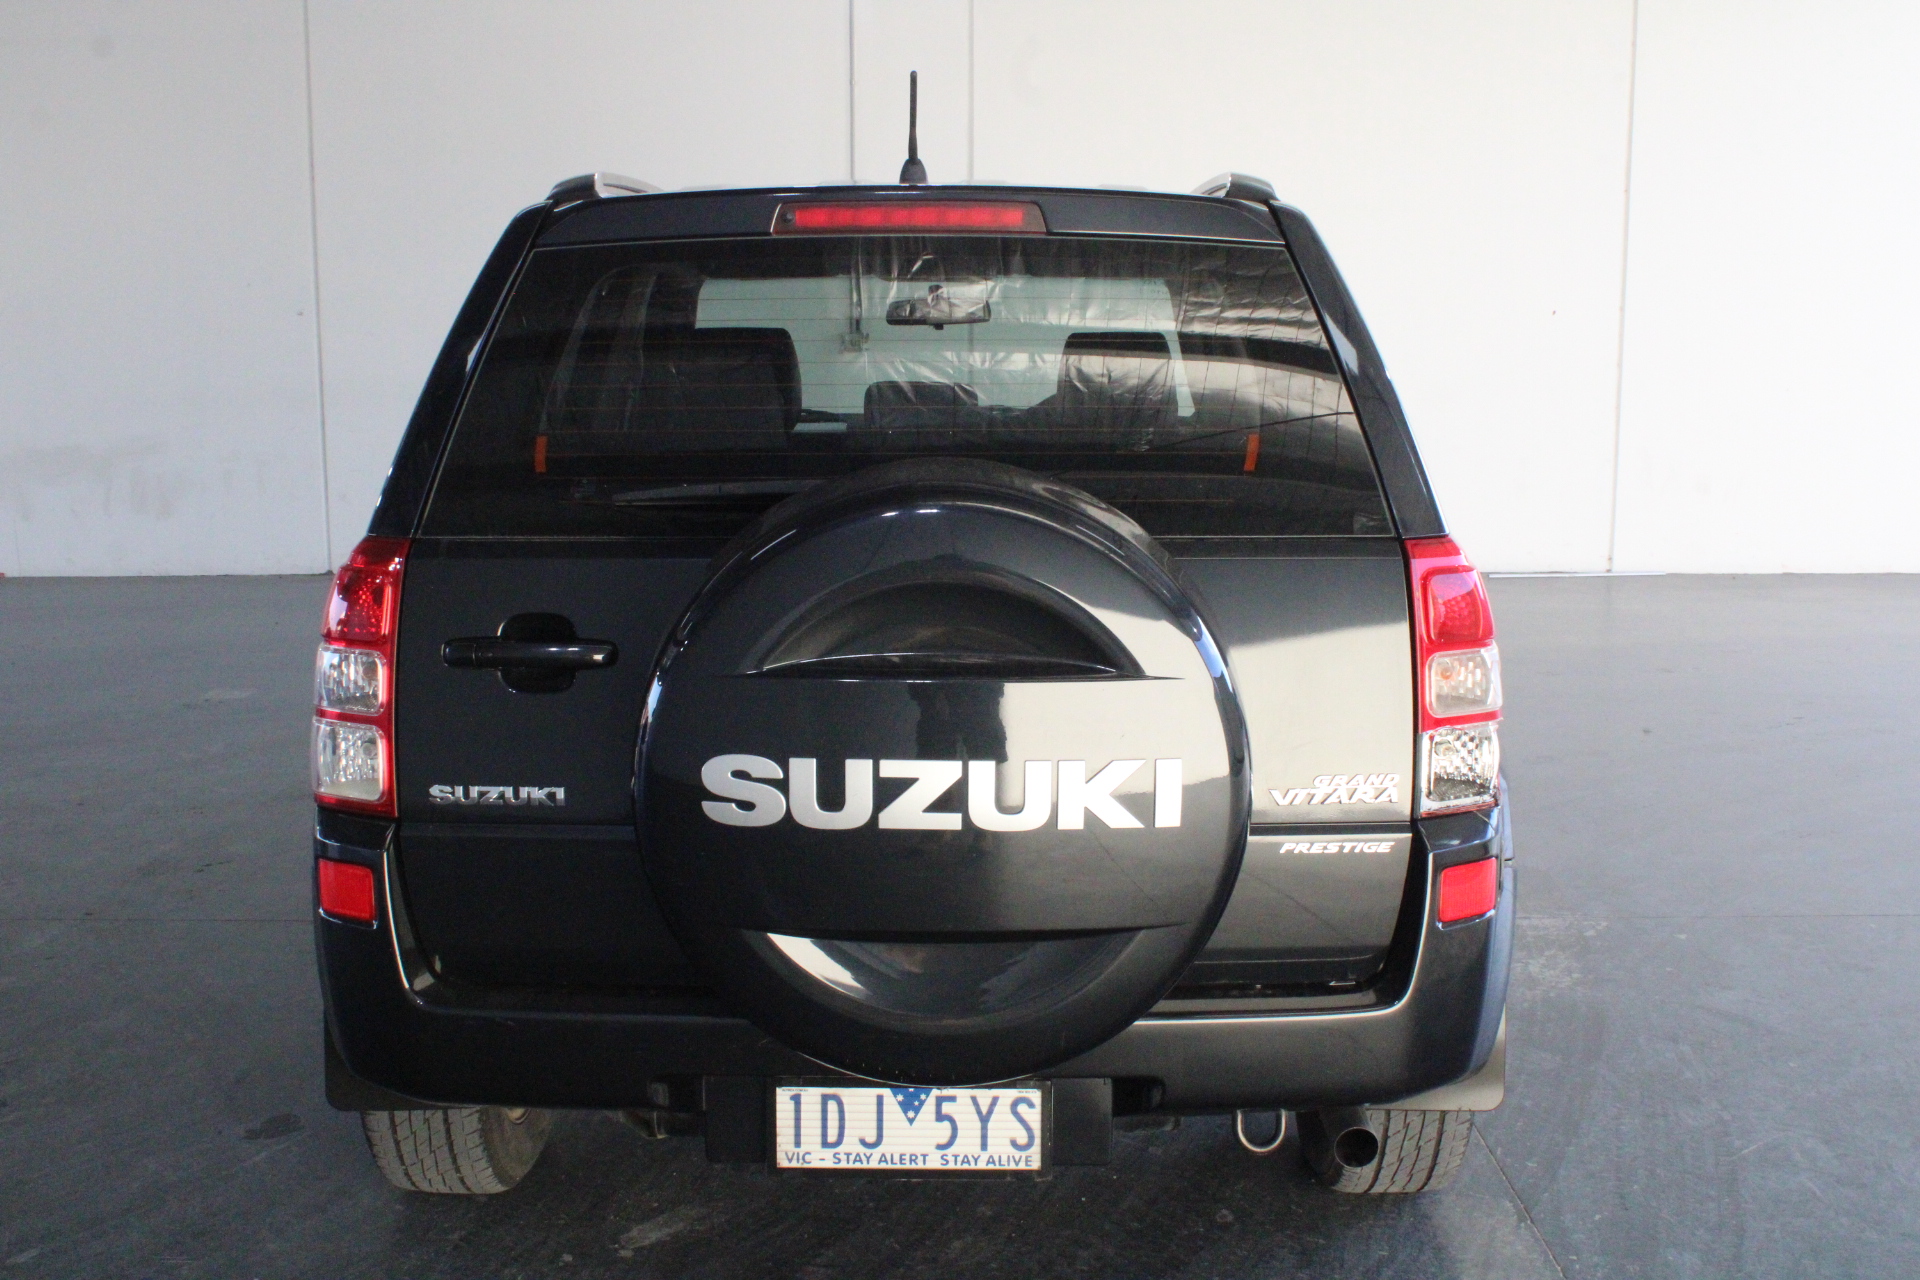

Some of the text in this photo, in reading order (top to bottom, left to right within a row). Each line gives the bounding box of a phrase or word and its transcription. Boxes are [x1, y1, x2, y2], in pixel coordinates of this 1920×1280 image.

[1312, 772, 1400, 788] GRAND
[428, 784, 566, 807] SUZUKI
[700, 753, 1183, 832] SUZUKI
[1268, 786, 1399, 807] VITARA
[1279, 841, 1396, 854] PRESTIGE
[784, 1151, 812, 1165] VIC
[832, 1151, 874, 1166] STAY
[878, 1152, 930, 1167] ALERT
[939, 1153, 982, 1167] STAY
[985, 1154, 1034, 1168] ALIVE
